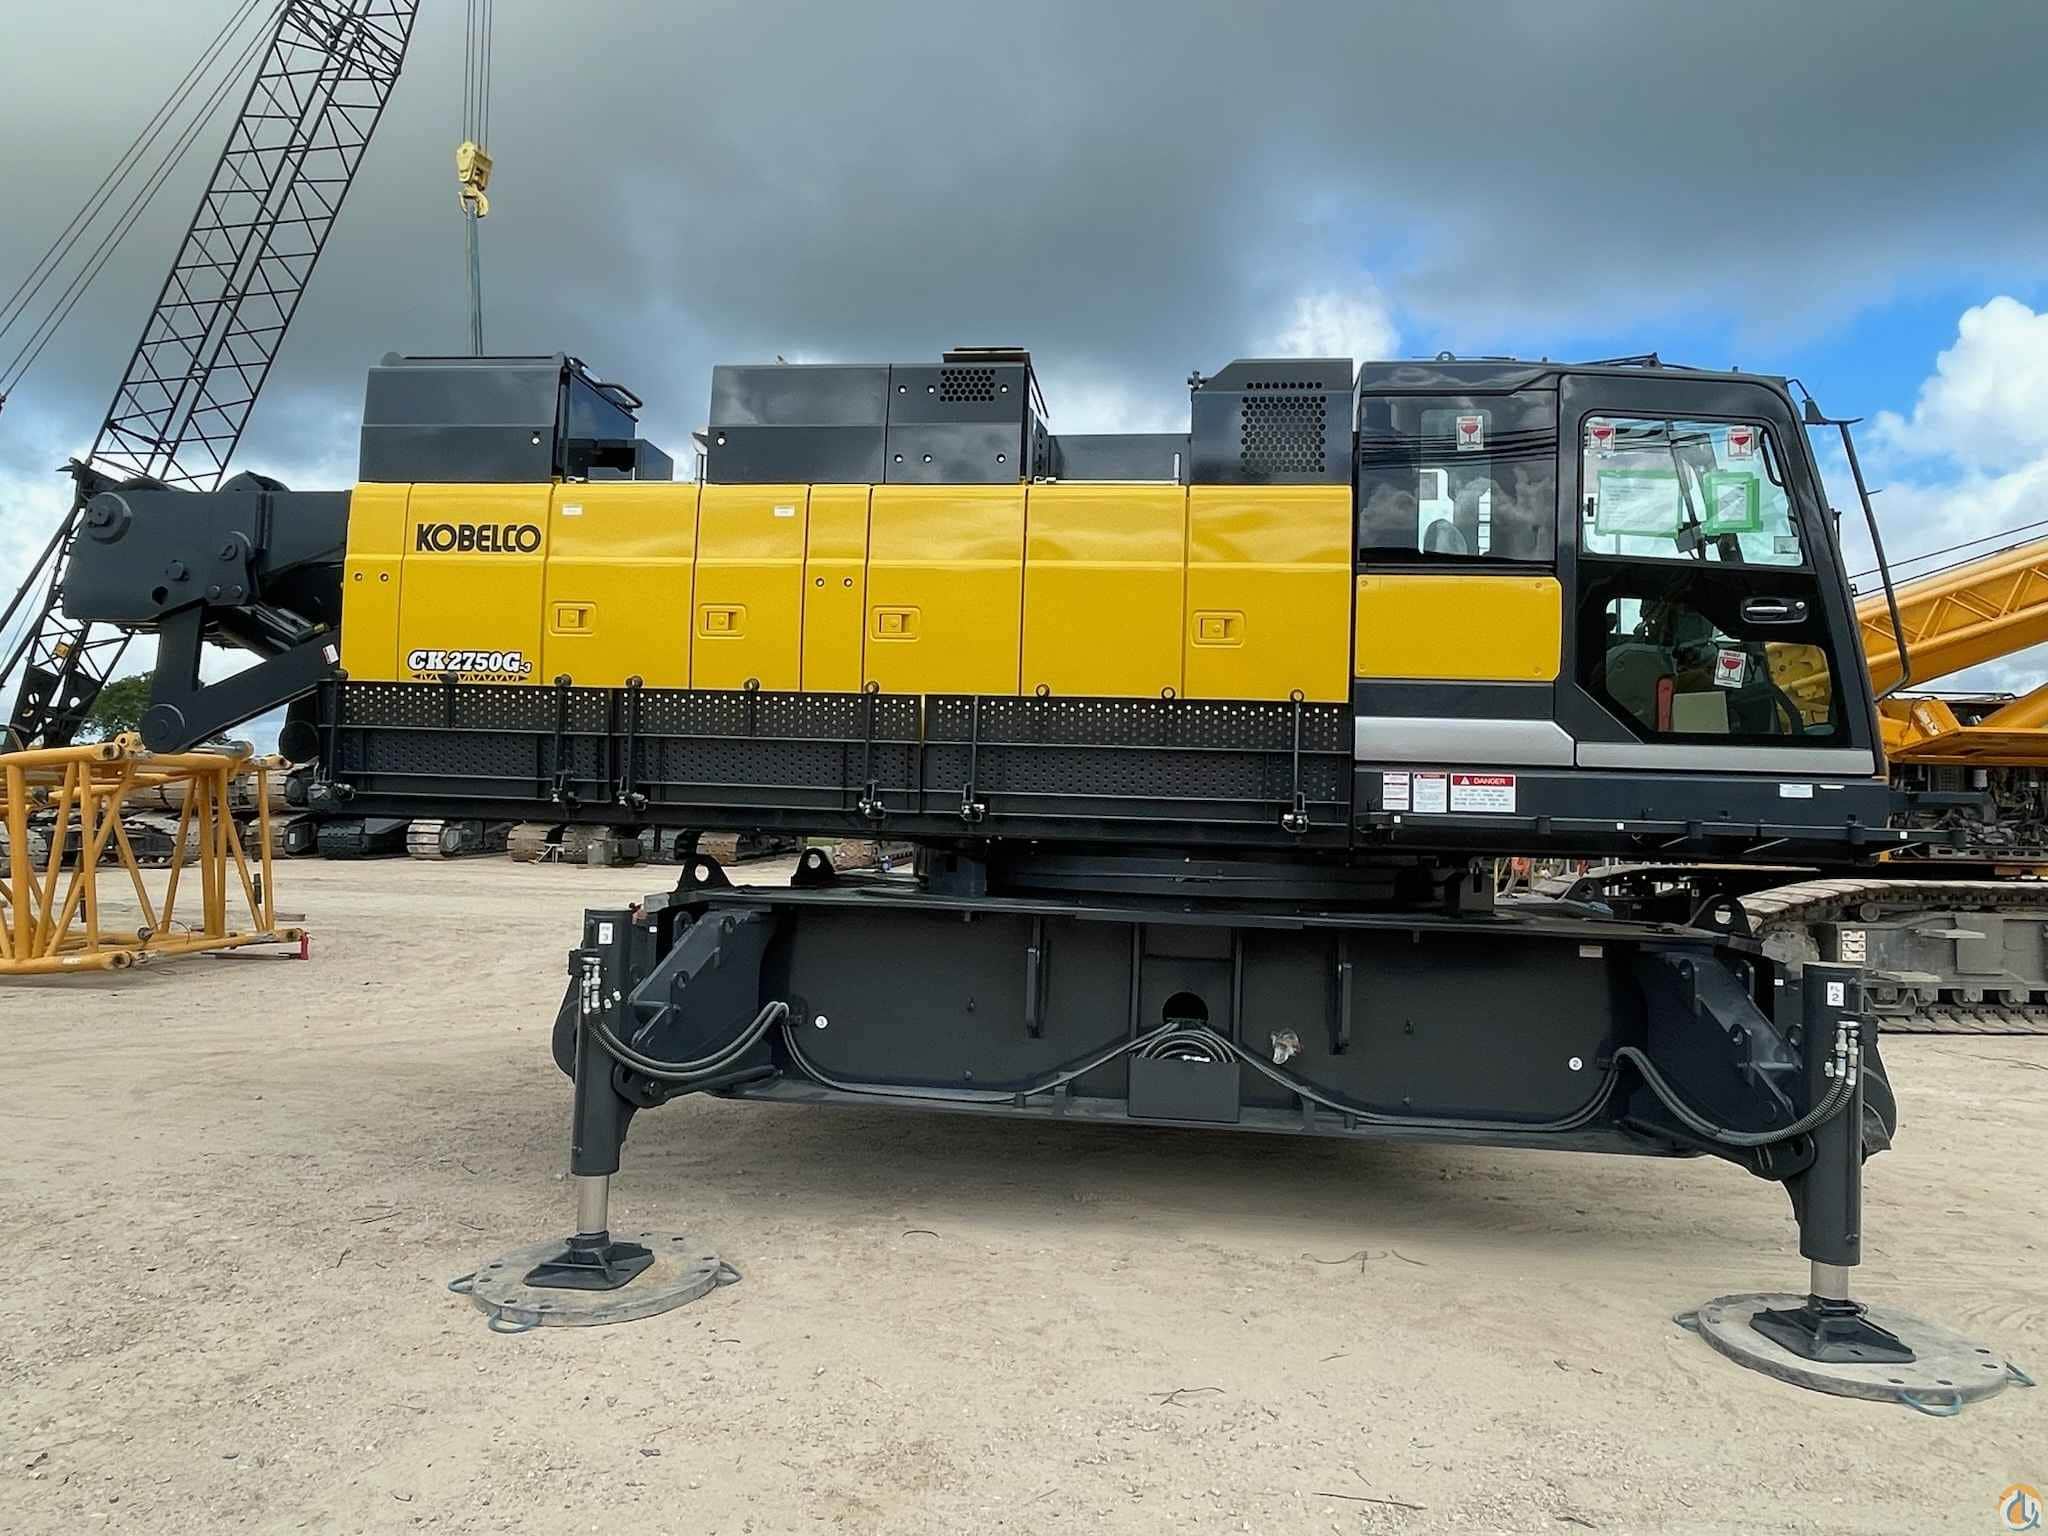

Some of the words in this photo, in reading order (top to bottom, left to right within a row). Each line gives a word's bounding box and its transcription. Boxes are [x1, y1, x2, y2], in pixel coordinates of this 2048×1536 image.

[416, 523, 541, 553] KOBELCO
[407, 649, 533, 673] CK2750G-3
[1473, 777, 1506, 785] DANGER
[1831, 992, 1840, 1002] 2
